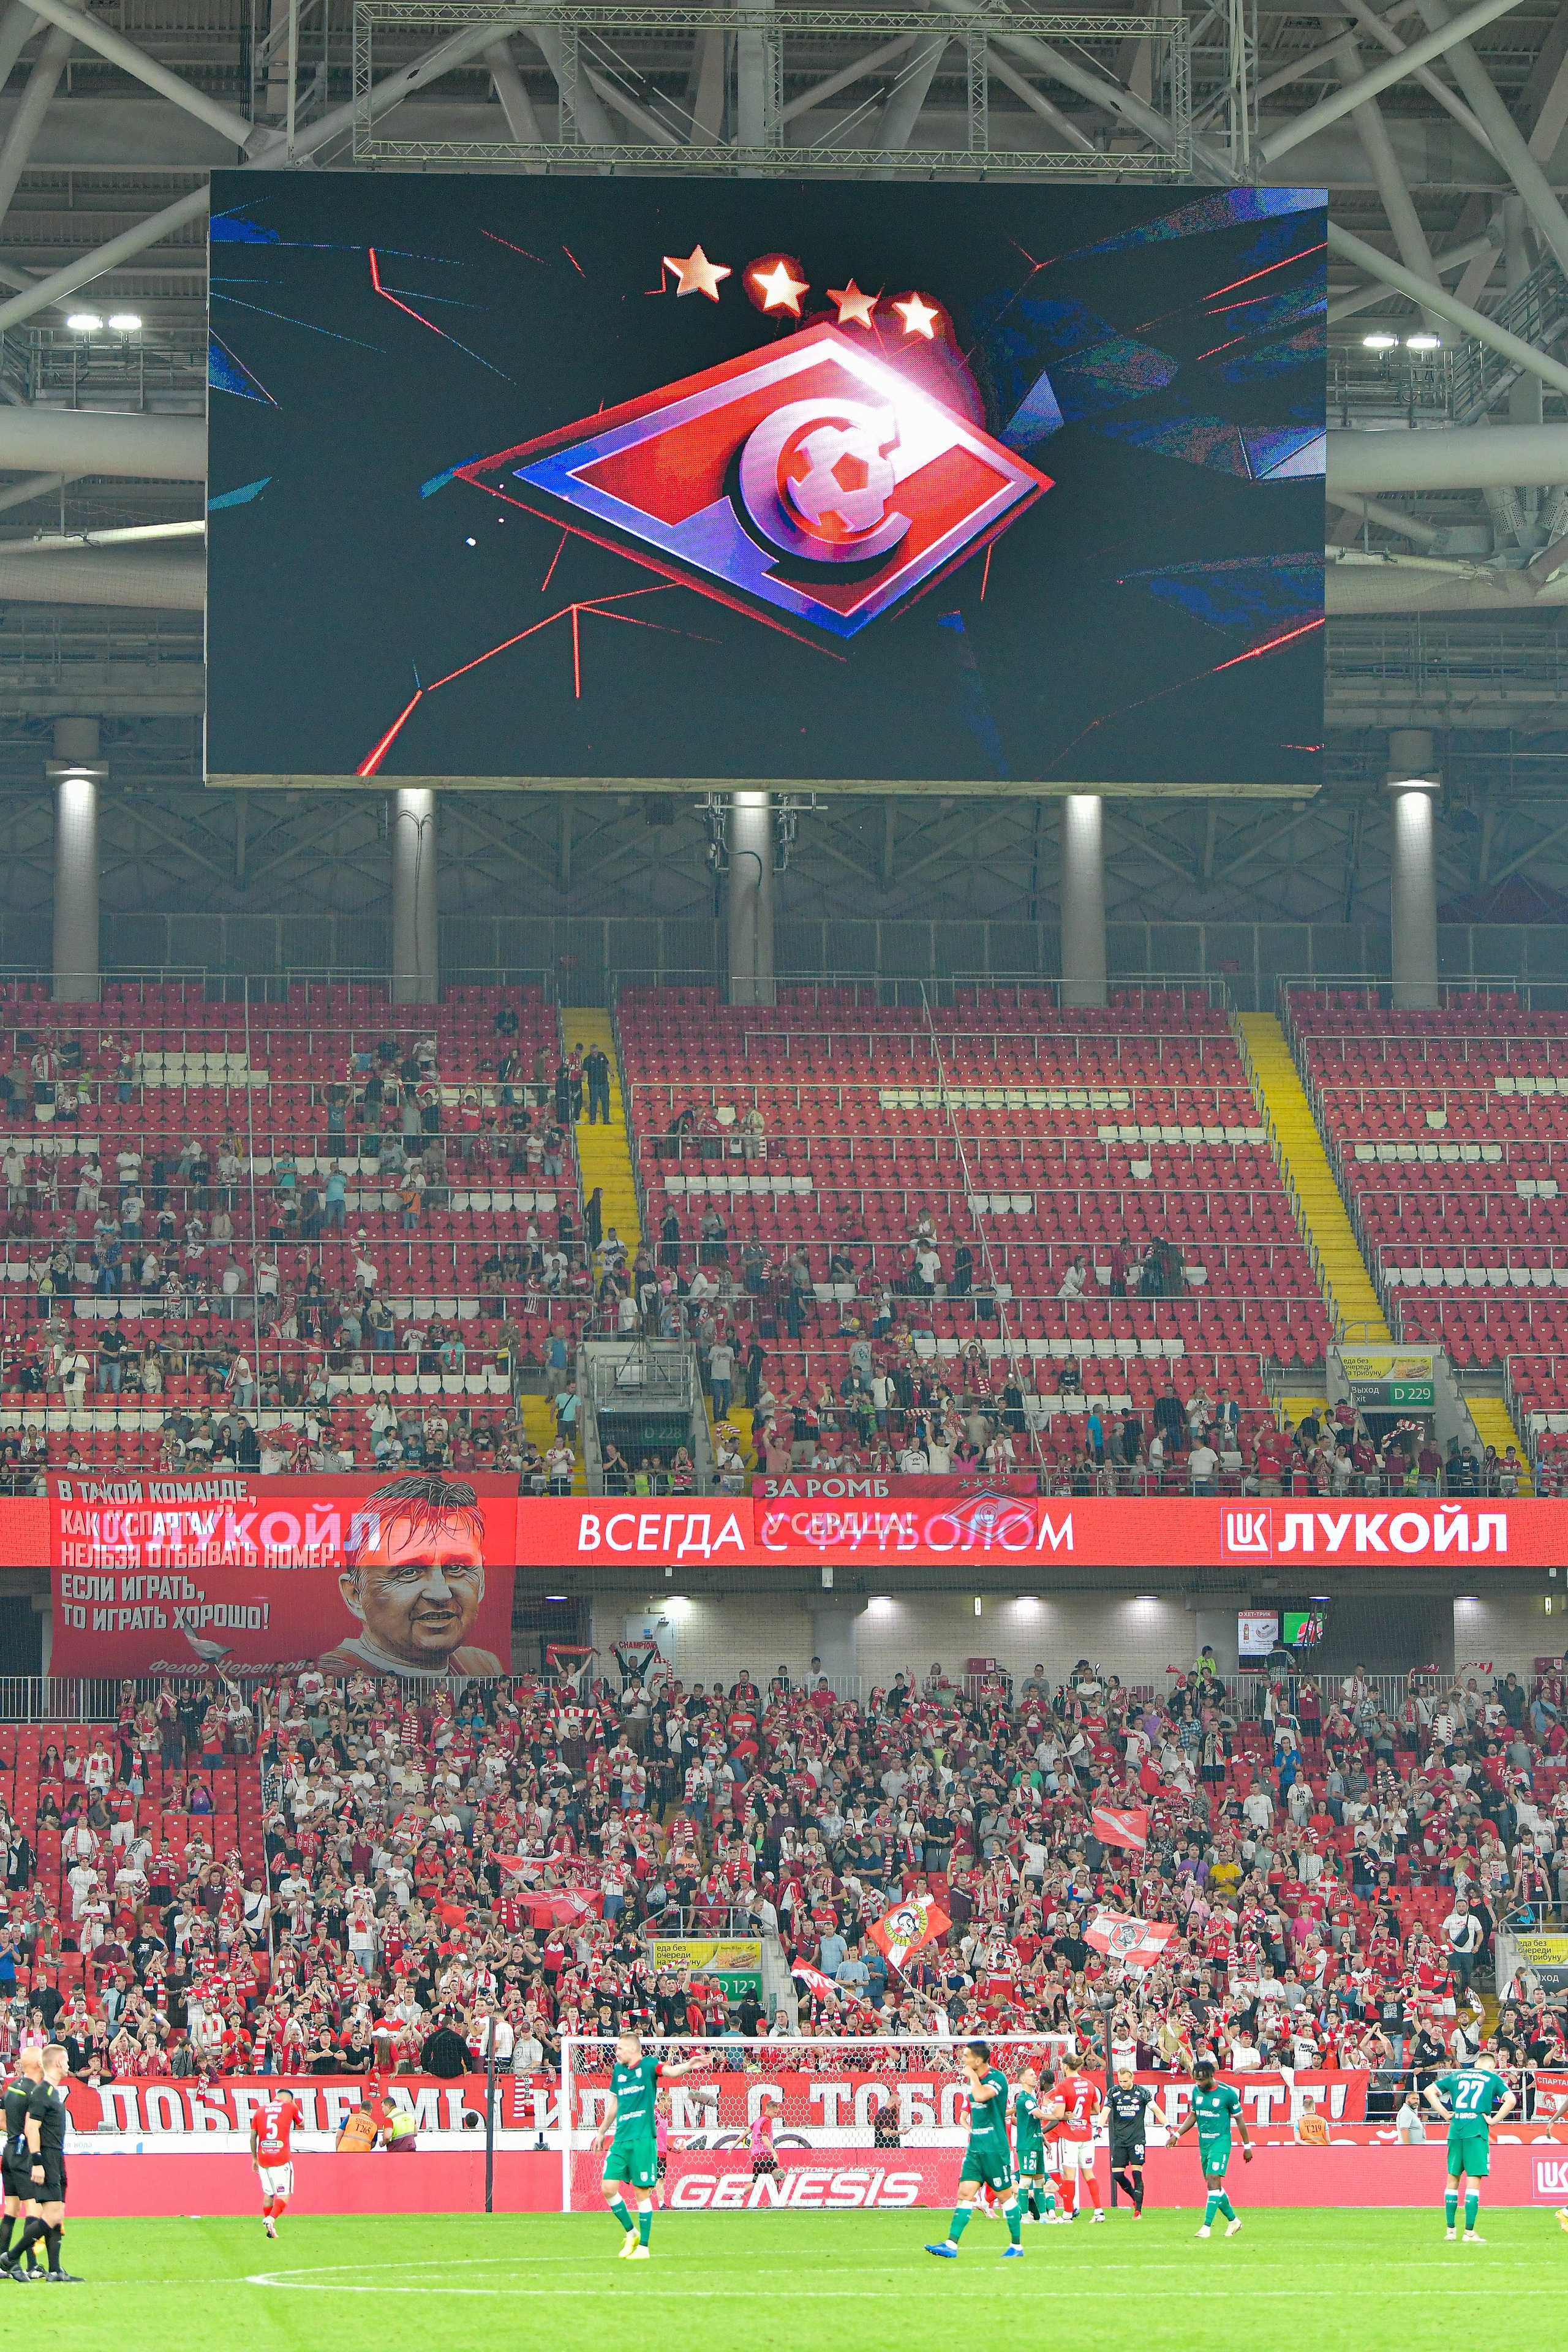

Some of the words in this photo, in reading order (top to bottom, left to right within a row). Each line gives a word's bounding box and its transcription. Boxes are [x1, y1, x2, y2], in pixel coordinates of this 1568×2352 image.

[1351, 1386, 1379, 1395] Выход
[1395, 1388, 1404, 1400] D
[1408, 1388, 1431, 1400] 229
[58, 1480, 73, 1501] В
[77, 1479, 143, 1505] ТАКОЙ
[149, 1479, 257, 1508] КОМАНДЕ,
[764, 1478, 801, 1498] ЗА
[806, 1479, 890, 1498] РОМБ
[61, 1509, 99, 1536] КАК
[577, 1513, 747, 1559] ВСЕГДА
[761, 1514, 791, 1551] С
[805, 1512, 1073, 1551] ФУТБОЛОМ
[764, 1512, 785, 1535] У
[791, 1511, 913, 1540] СЕРДЦА!
[1278, 1504, 1508, 1553] ЛУКОЙЛ
[61, 1541, 141, 1569] НЕЛЬЗЯ
[148, 1541, 257, 1569] ОТБЫВАТЬ
[264, 1543, 341, 1569] НОМЕР.
[61, 1573, 115, 1601] ЕСЛИ
[122, 1575, 205, 1603] ИГРАТЬ,
[61, 1602, 86, 1629] ТО
[93, 1606, 167, 1632] ИГРАТЬ
[173, 1603, 270, 1630] ХОРОШО!
[149, 1659, 209, 1678] Федор
[219, 1659, 307, 1676] Черенов
[1422, 2043, 1438, 2056] Kappa
[1537, 2076, 1568, 2086] СПАРТА
[388, 2086, 504, 2130] МЫ
[747, 2082, 785, 2128] С
[1072, 2096, 1085, 2119] 6
[1455, 2080, 1484, 2109] 27
[266, 2114, 279, 2139] 5
[355, 2117, 374, 2128] STEWARD
[356, 2124, 371, 2135] T265
[1134, 2144, 1144, 2154] 98
[670, 2172, 924, 2208] GENESIS
